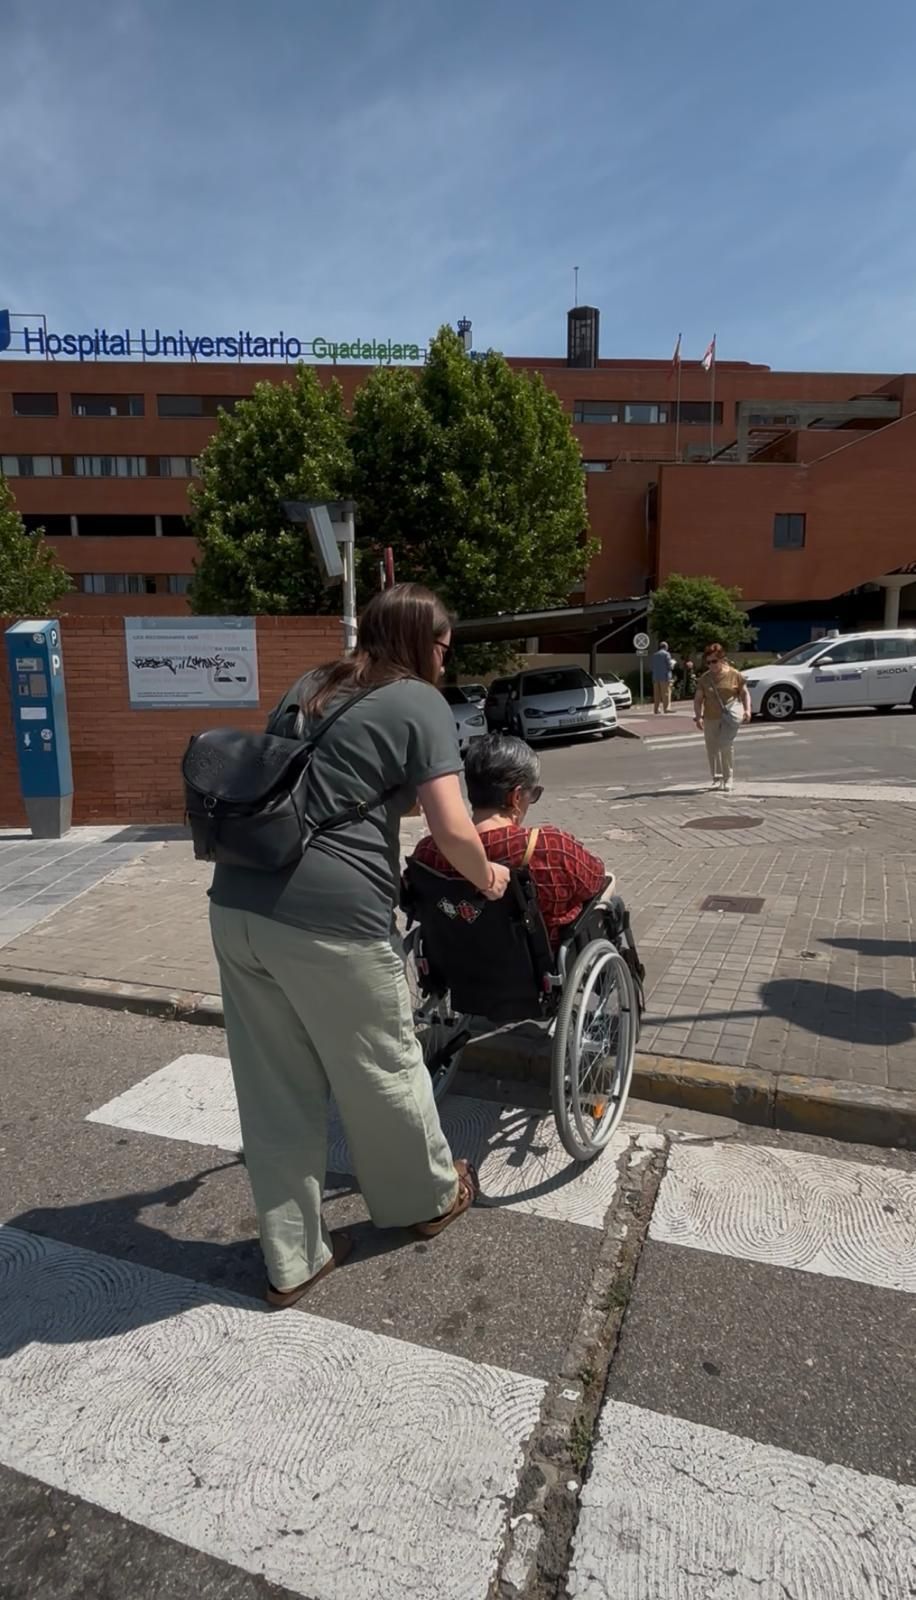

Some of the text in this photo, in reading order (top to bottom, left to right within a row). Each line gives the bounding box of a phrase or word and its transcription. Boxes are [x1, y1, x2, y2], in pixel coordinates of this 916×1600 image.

[24, 327, 420, 365] Hospital Universitario Guadalajara
[51, 654, 60, 676] P
